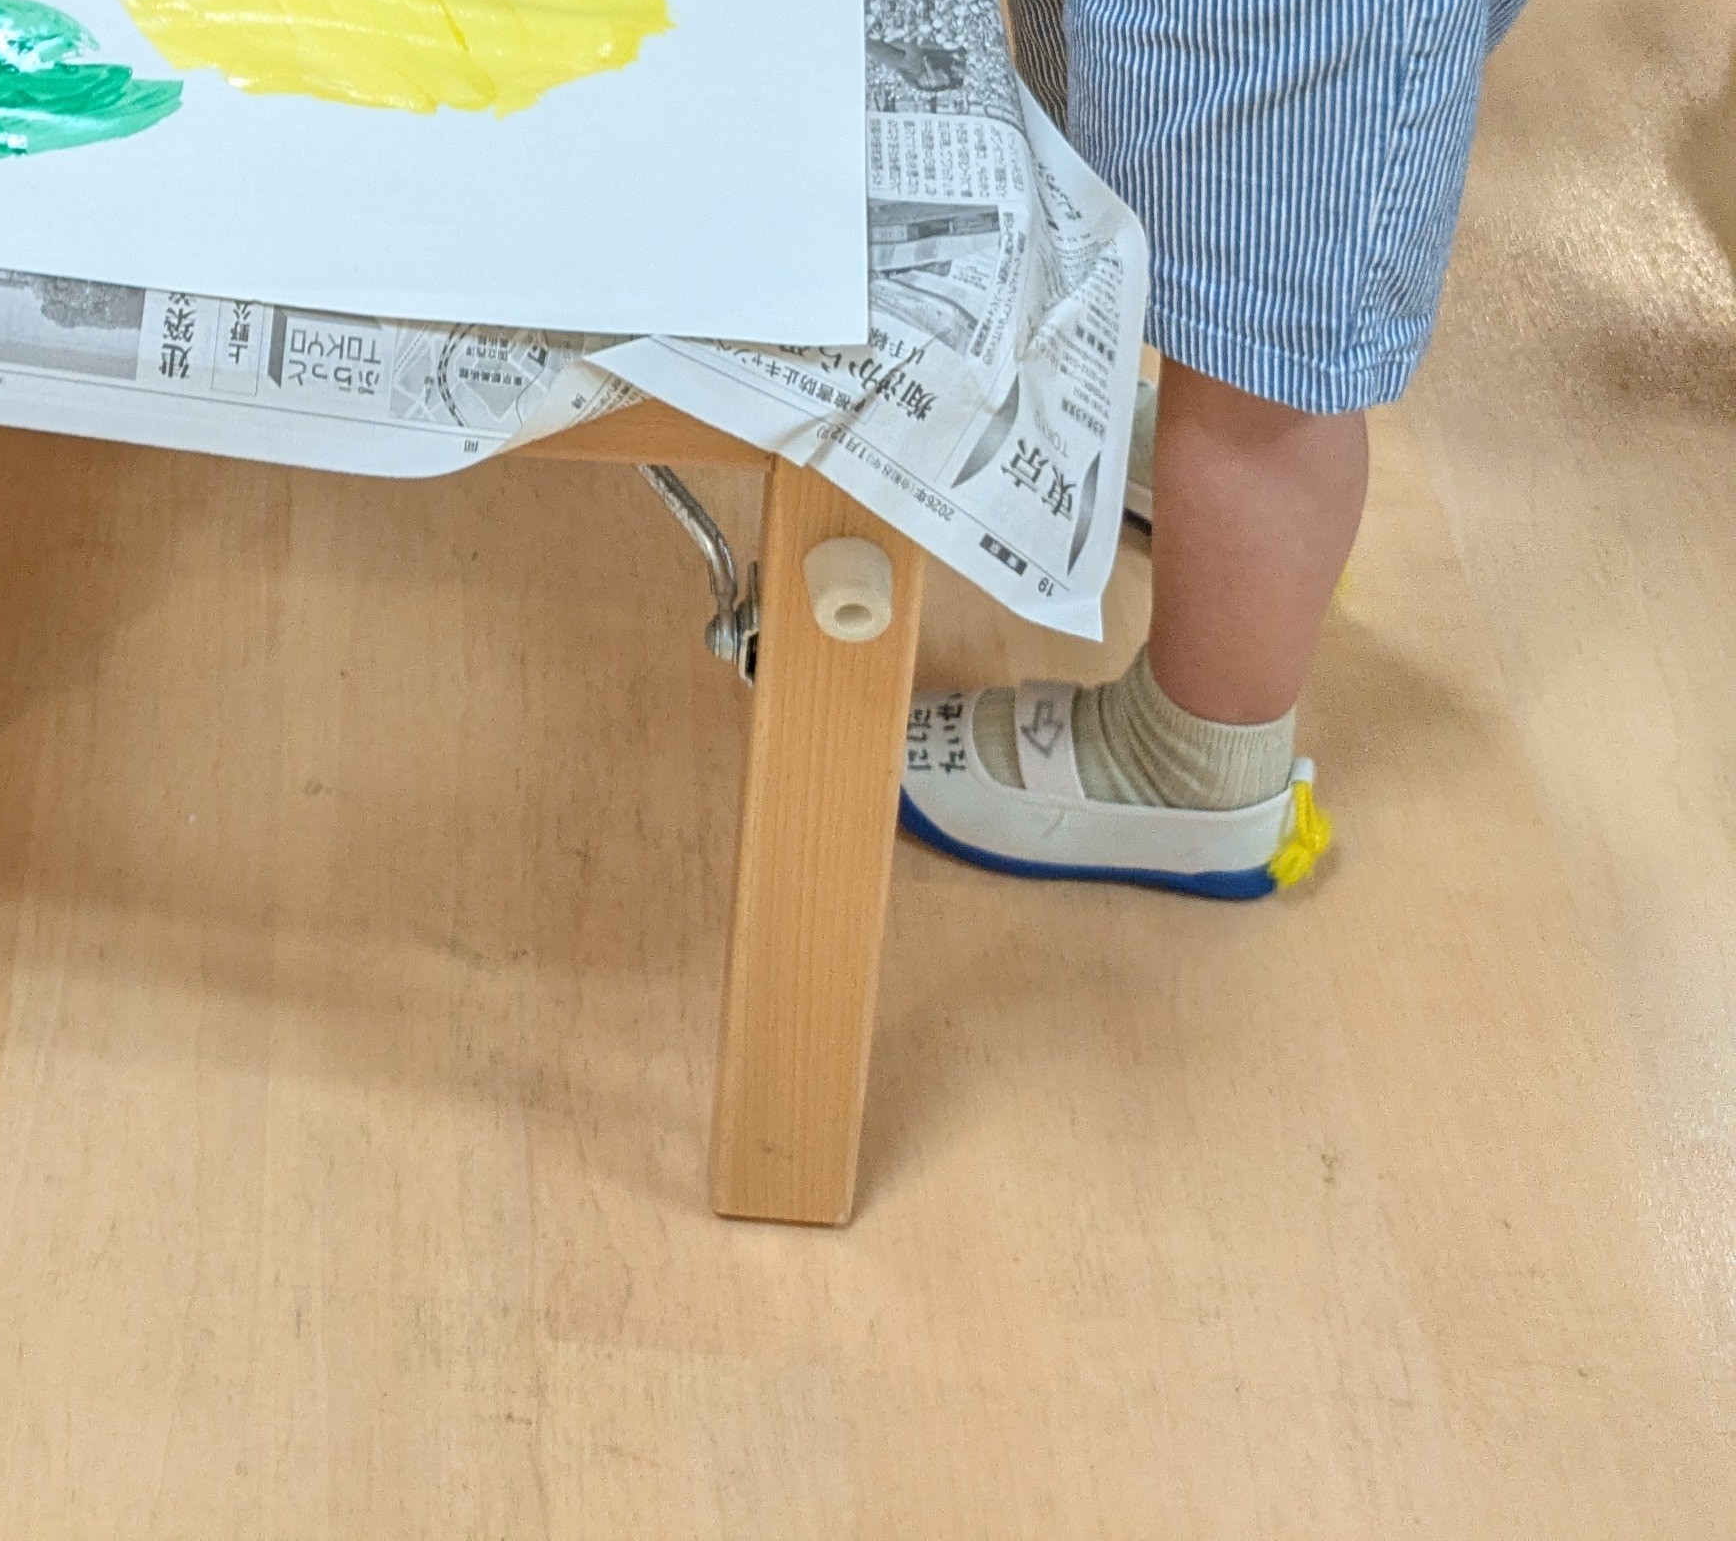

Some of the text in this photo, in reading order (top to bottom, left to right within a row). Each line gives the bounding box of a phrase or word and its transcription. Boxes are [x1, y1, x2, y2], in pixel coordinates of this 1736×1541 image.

[291, 328, 382, 365] TOKYO
[1000, 438, 1078, 521] 東京
[1037, 577, 1055, 597] 19
